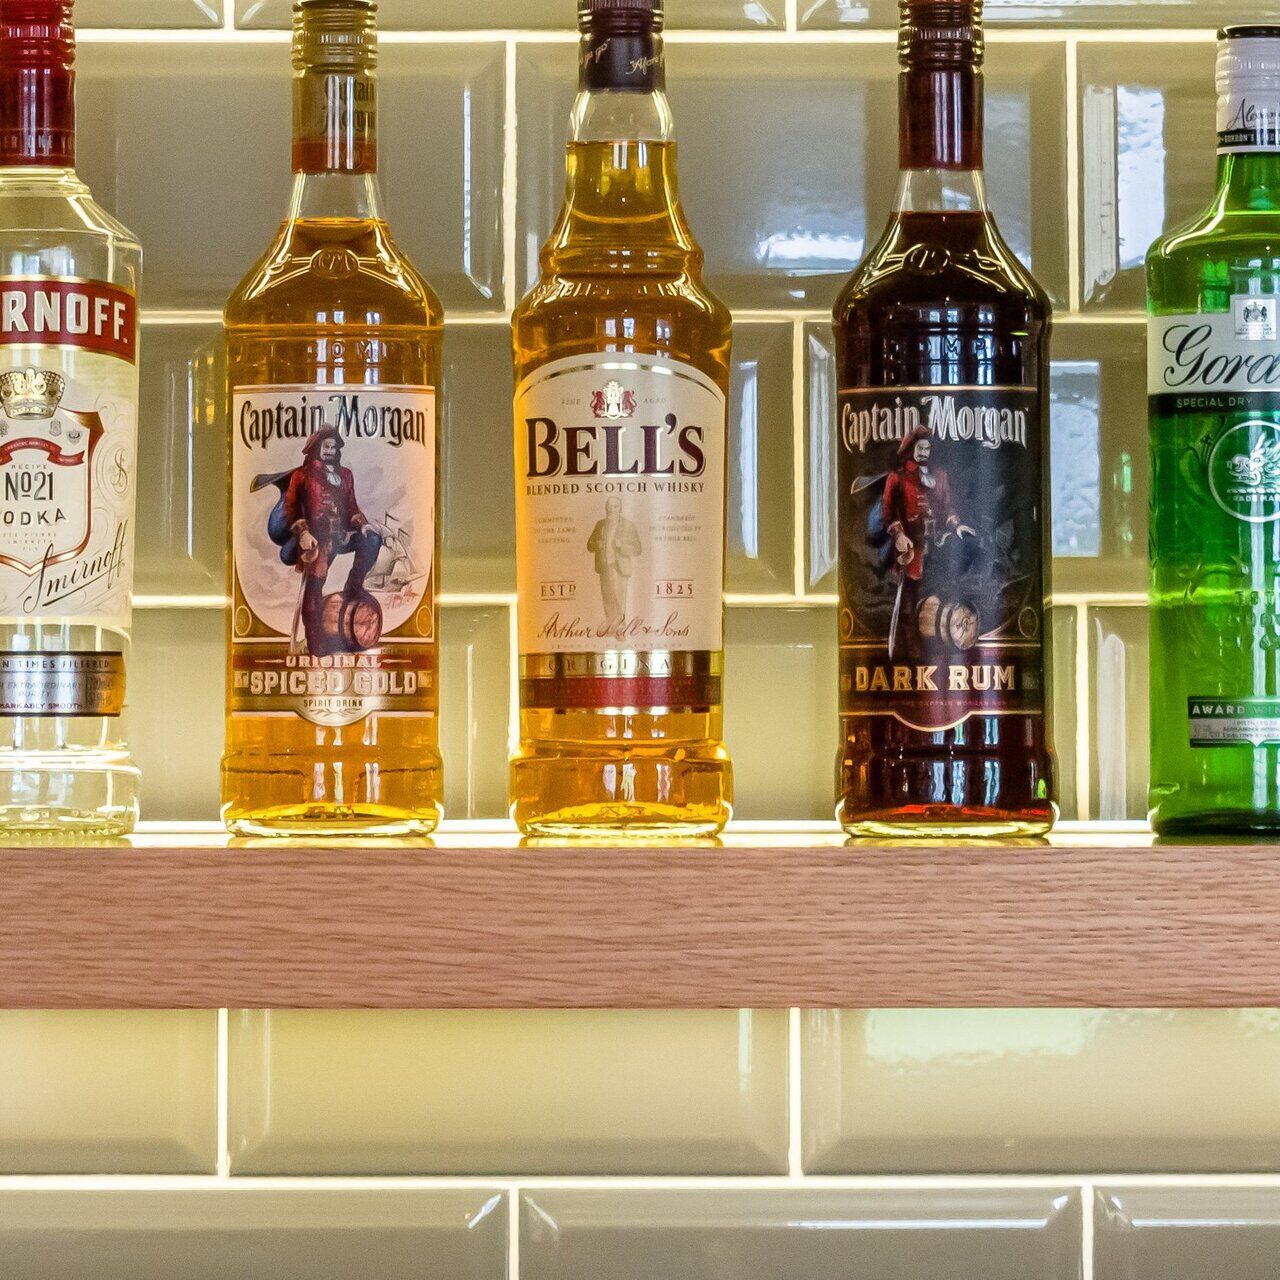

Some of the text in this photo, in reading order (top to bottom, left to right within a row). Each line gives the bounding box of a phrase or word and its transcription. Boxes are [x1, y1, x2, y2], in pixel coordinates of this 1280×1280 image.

[1176, 398, 1252, 408] SPECIAL DRY
[240, 394, 426, 450] Captain Morgan
[841, 395, 1028, 453] Captain Morgan
[525, 413, 706, 477] BELL'S
[526, 482, 705, 496] BLENDED SCOTCH WHISKY
[1232, 495, 1258, 503] RADE
[22, 519, 128, 614] Smirnoff
[656, 583, 693, 595] 1825
[18, 660, 55, 668] TIMES
[62, 660, 109, 668] FILTERED
[286, 655, 381, 668] ORIGINAL
[548, 658, 687, 670] ORIGINA
[250, 671, 417, 695] SPICED GOLD
[855, 665, 1015, 691] DARK RUM
[303, 699, 363, 708] SPIRIT DRINK
[1192, 704, 1245, 715] AWARD
